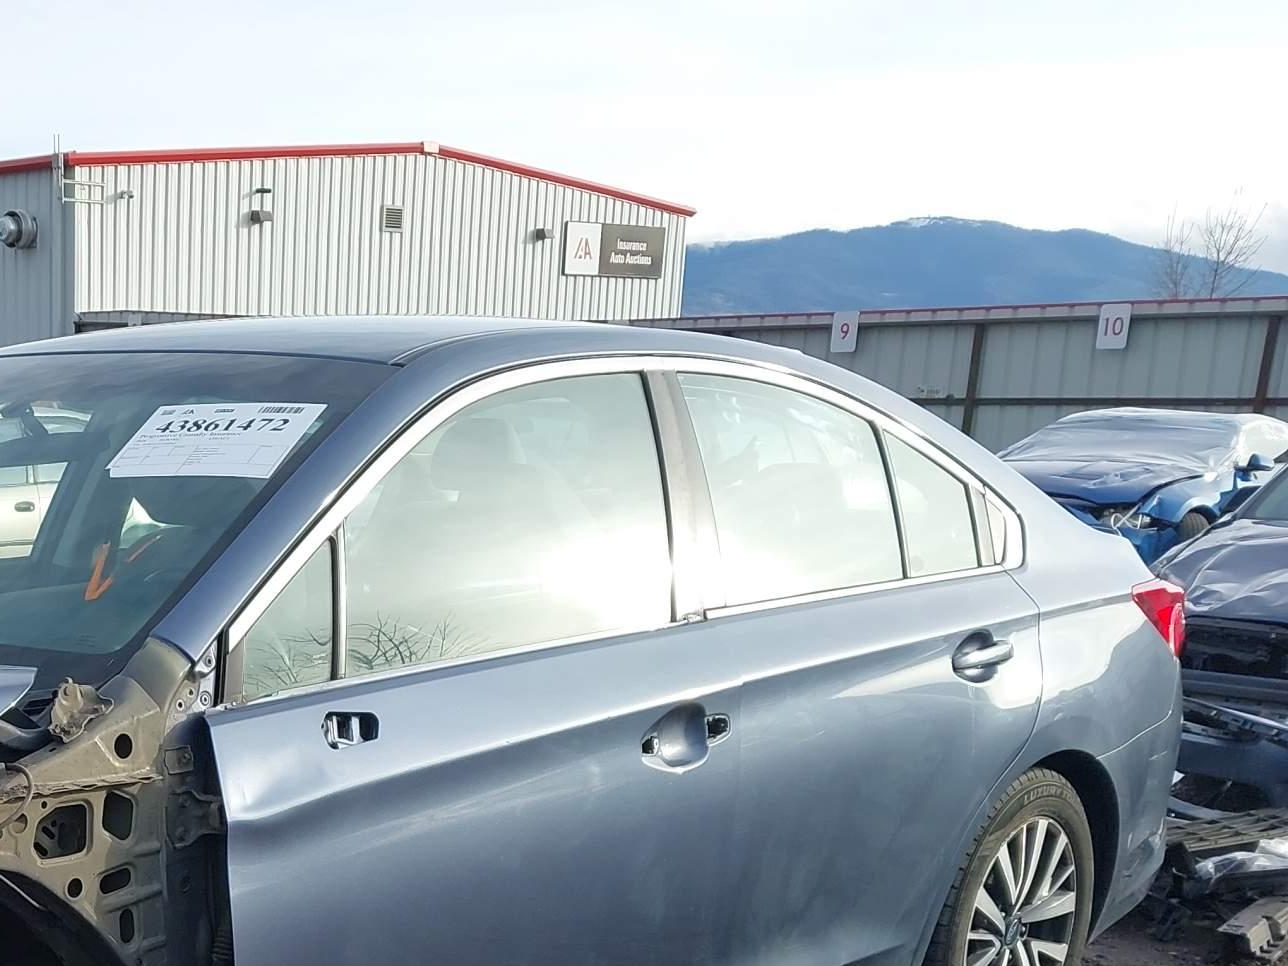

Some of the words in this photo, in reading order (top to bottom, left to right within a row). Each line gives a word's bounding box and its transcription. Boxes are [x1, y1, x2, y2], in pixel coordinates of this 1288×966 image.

[617, 238, 648, 251] Insurance
[610, 251, 625, 264] Auto
[625, 253, 652, 265] Auctions
[840, 323, 850, 340] 9
[1103, 315, 1124, 337] 10
[155, 417, 290, 433] 43861472
